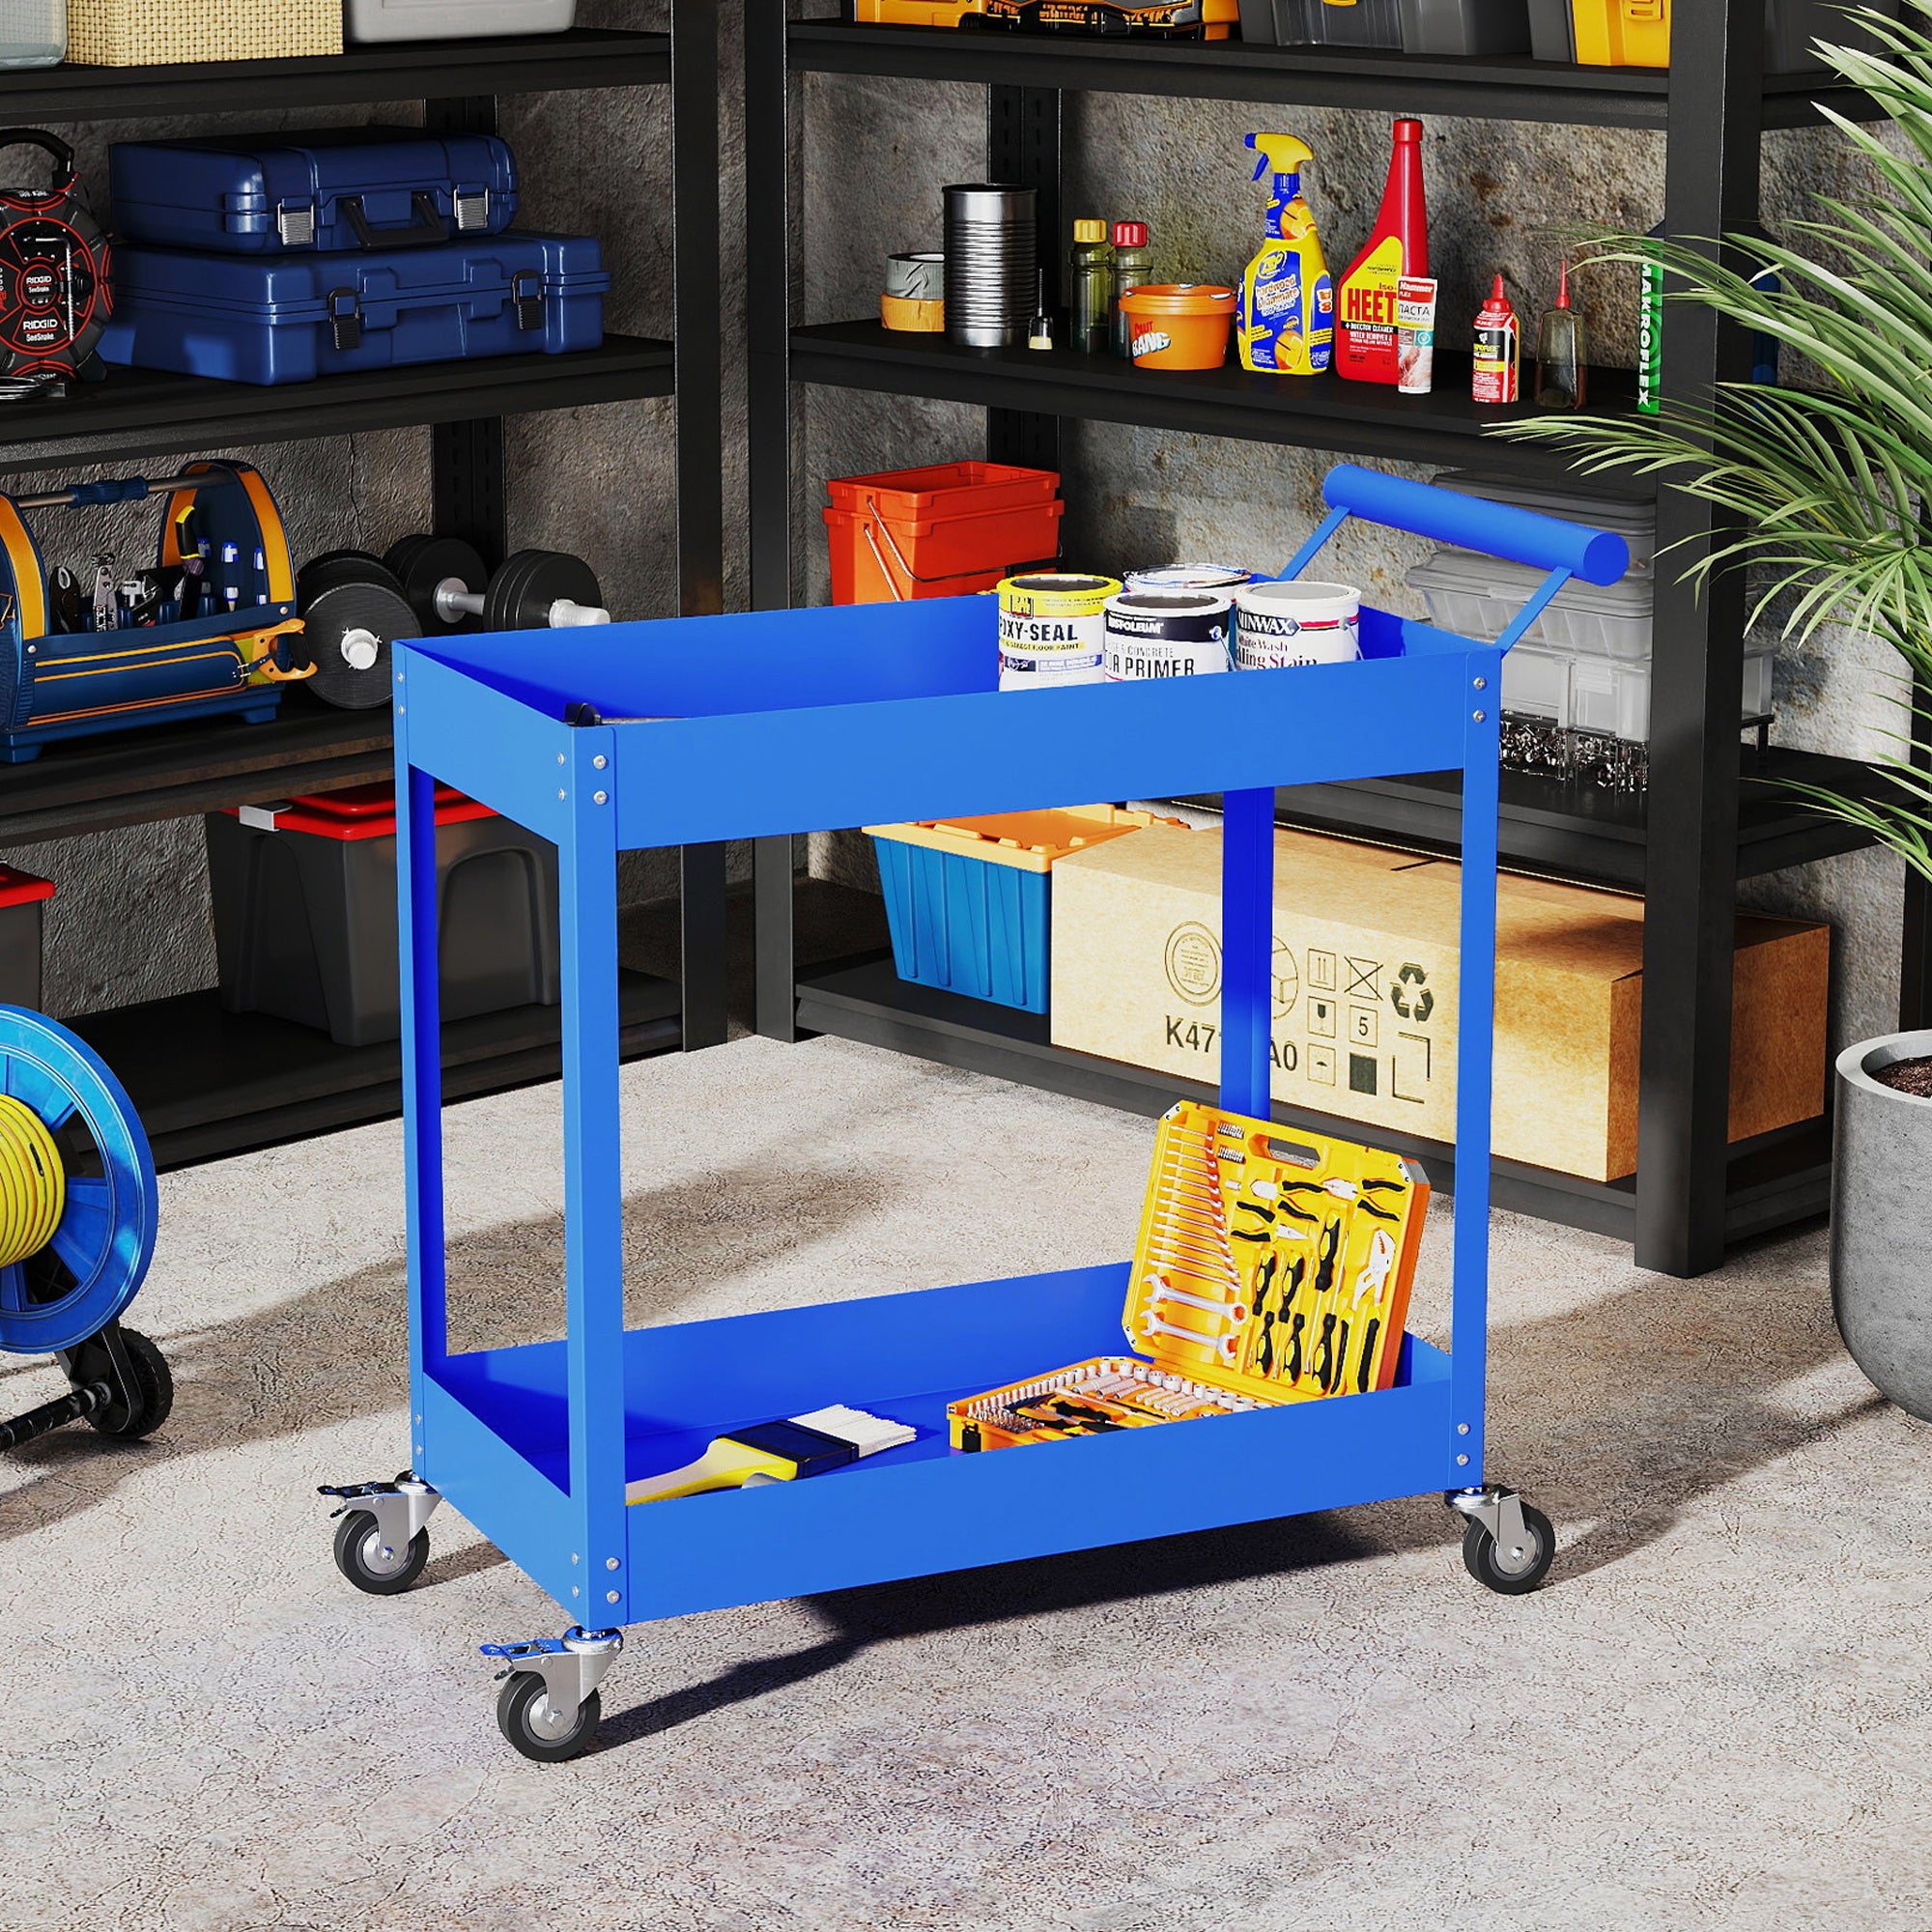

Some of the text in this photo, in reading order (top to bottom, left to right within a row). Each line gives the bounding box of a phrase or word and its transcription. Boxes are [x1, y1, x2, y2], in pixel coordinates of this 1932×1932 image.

[1256, 275, 1295, 296] hardwood
[1348, 288, 1397, 324] HEET
[1399, 304, 1431, 316] ПАСТА
[23, 319, 58, 331] RIDGID
[1132, 331, 1171, 357] BANG
[1127, 645, 1174, 658] CONCRETE
[1258, 639, 1288, 651] Wash
[1125, 658, 1195, 678] PRIMER
[1269, 653, 1318, 668] Stain
[1358, 1016, 1368, 1037] 5
